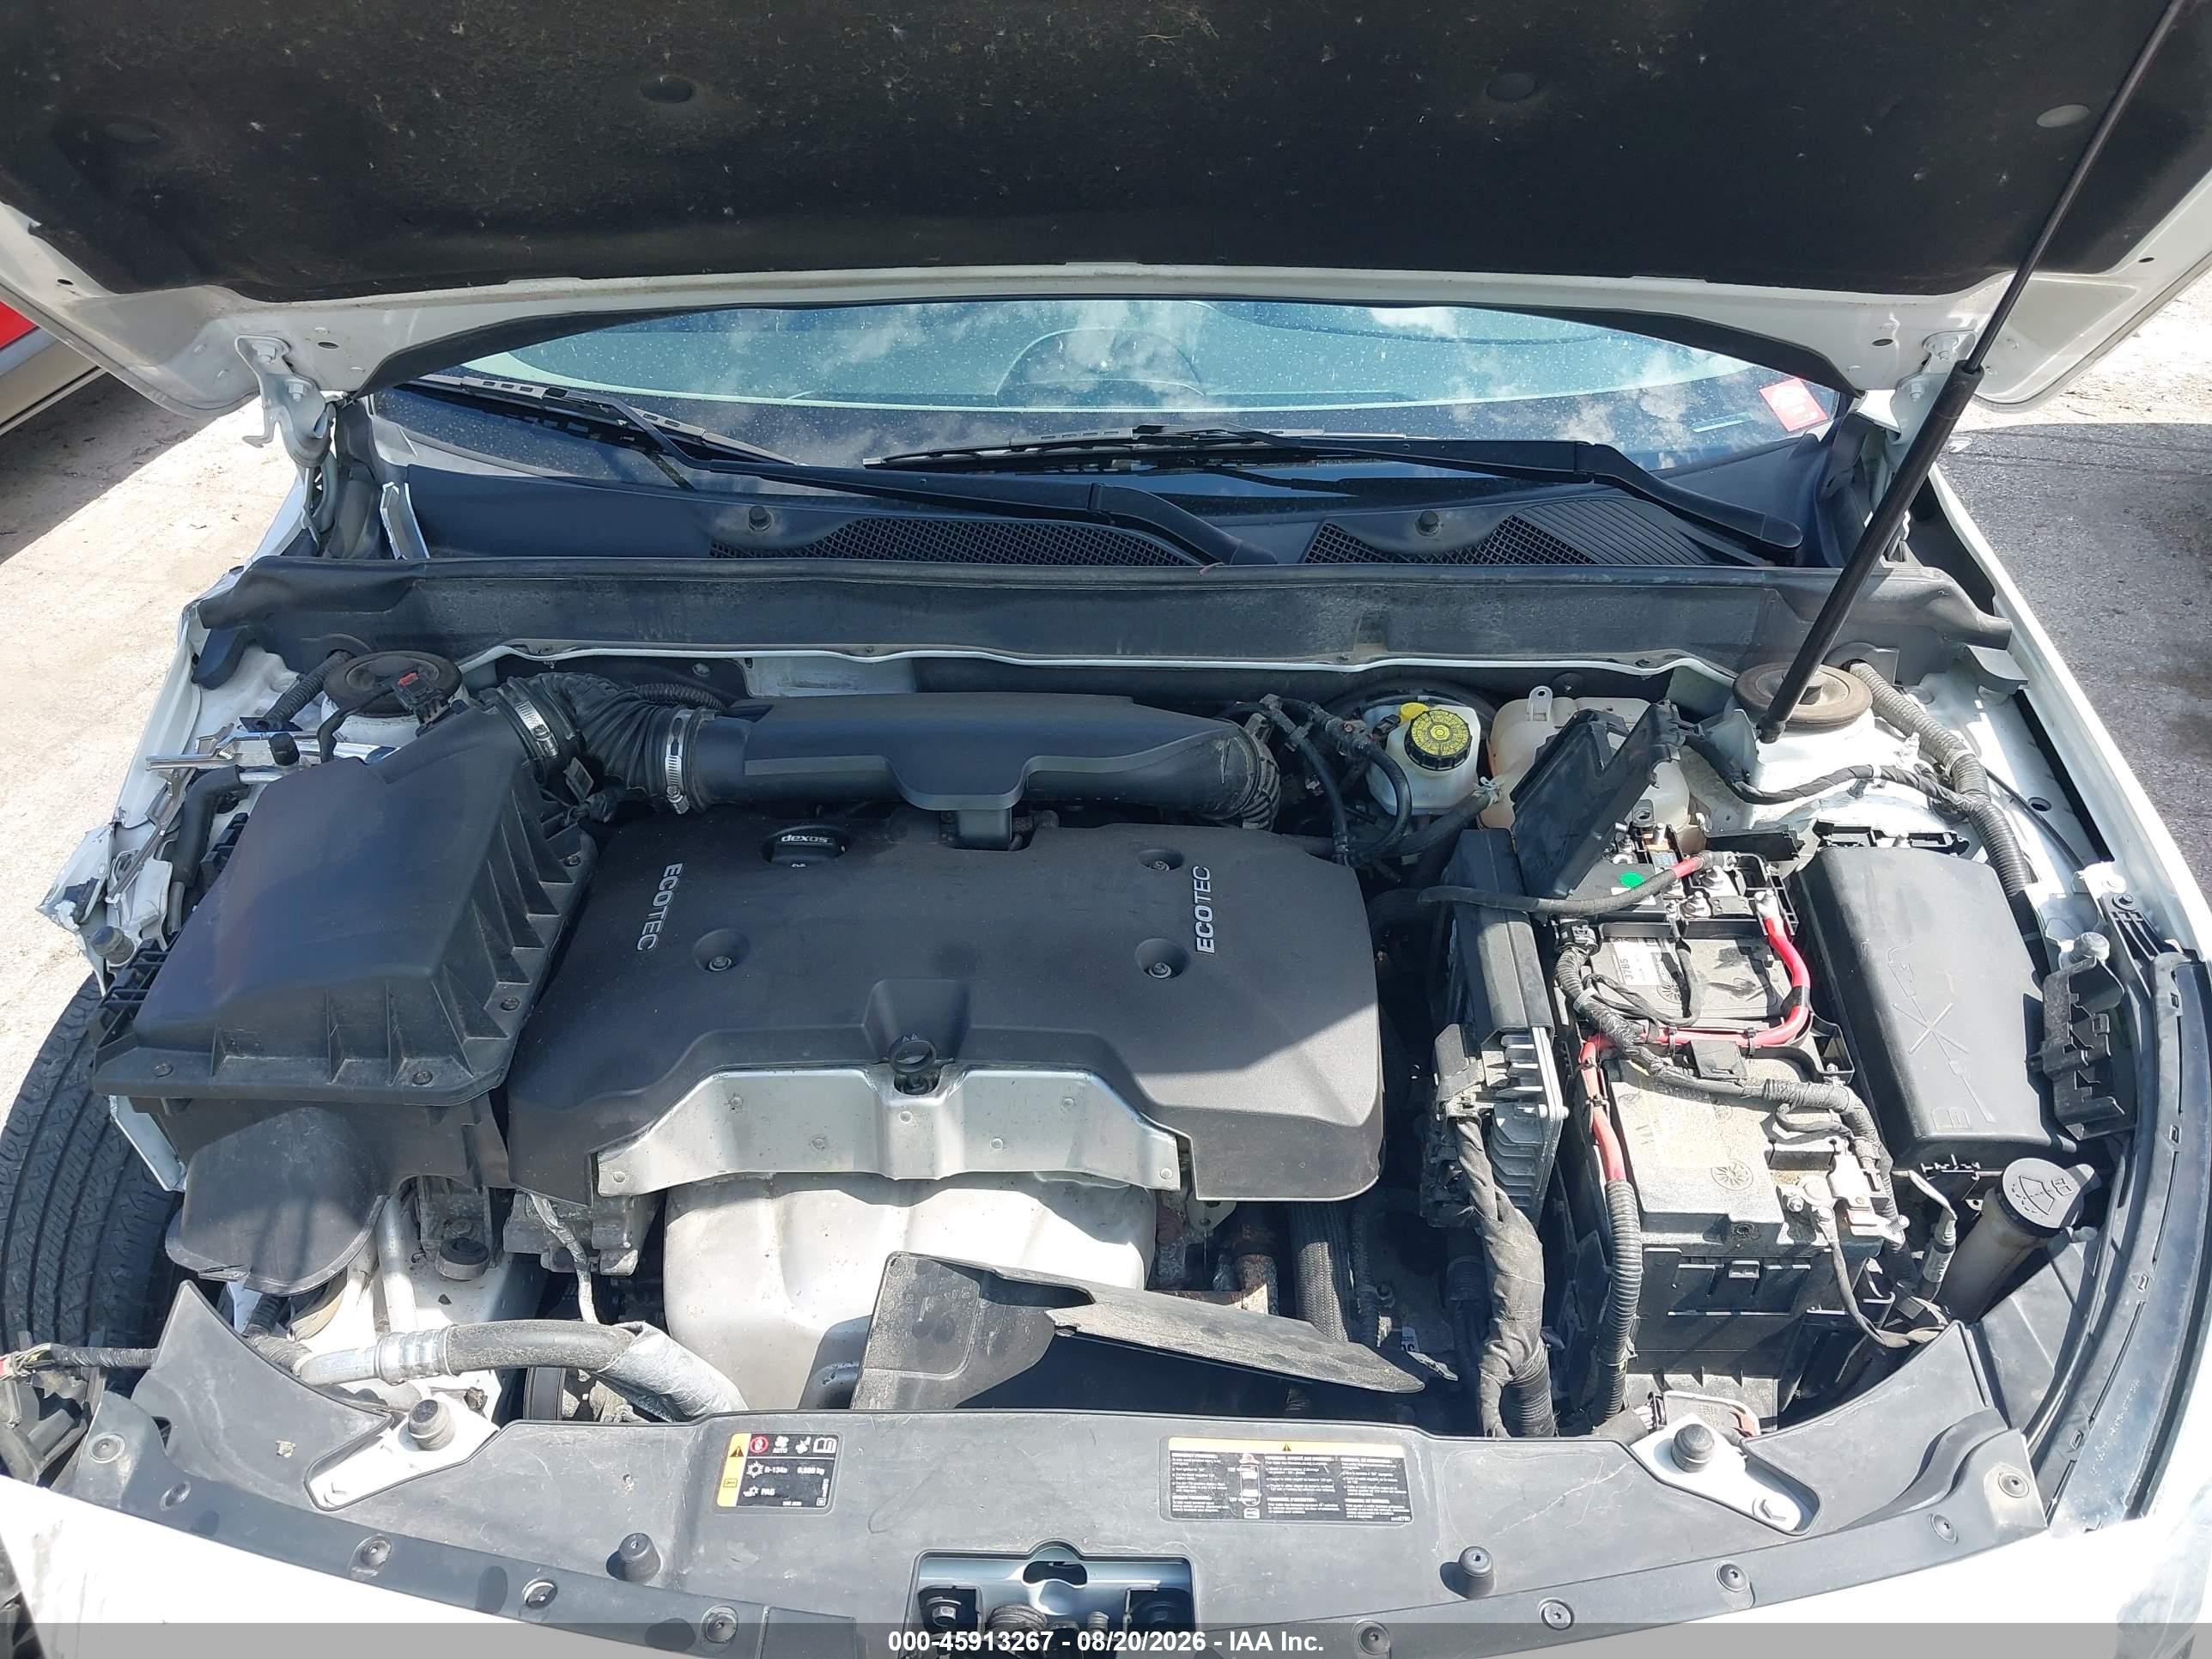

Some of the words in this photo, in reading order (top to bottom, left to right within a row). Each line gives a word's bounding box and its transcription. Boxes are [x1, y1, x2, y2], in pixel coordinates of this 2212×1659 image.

[781, 834, 830, 843] dexos
[636, 862, 684, 951] ECOTEC
[1192, 865, 1216, 954] ECOTEC
